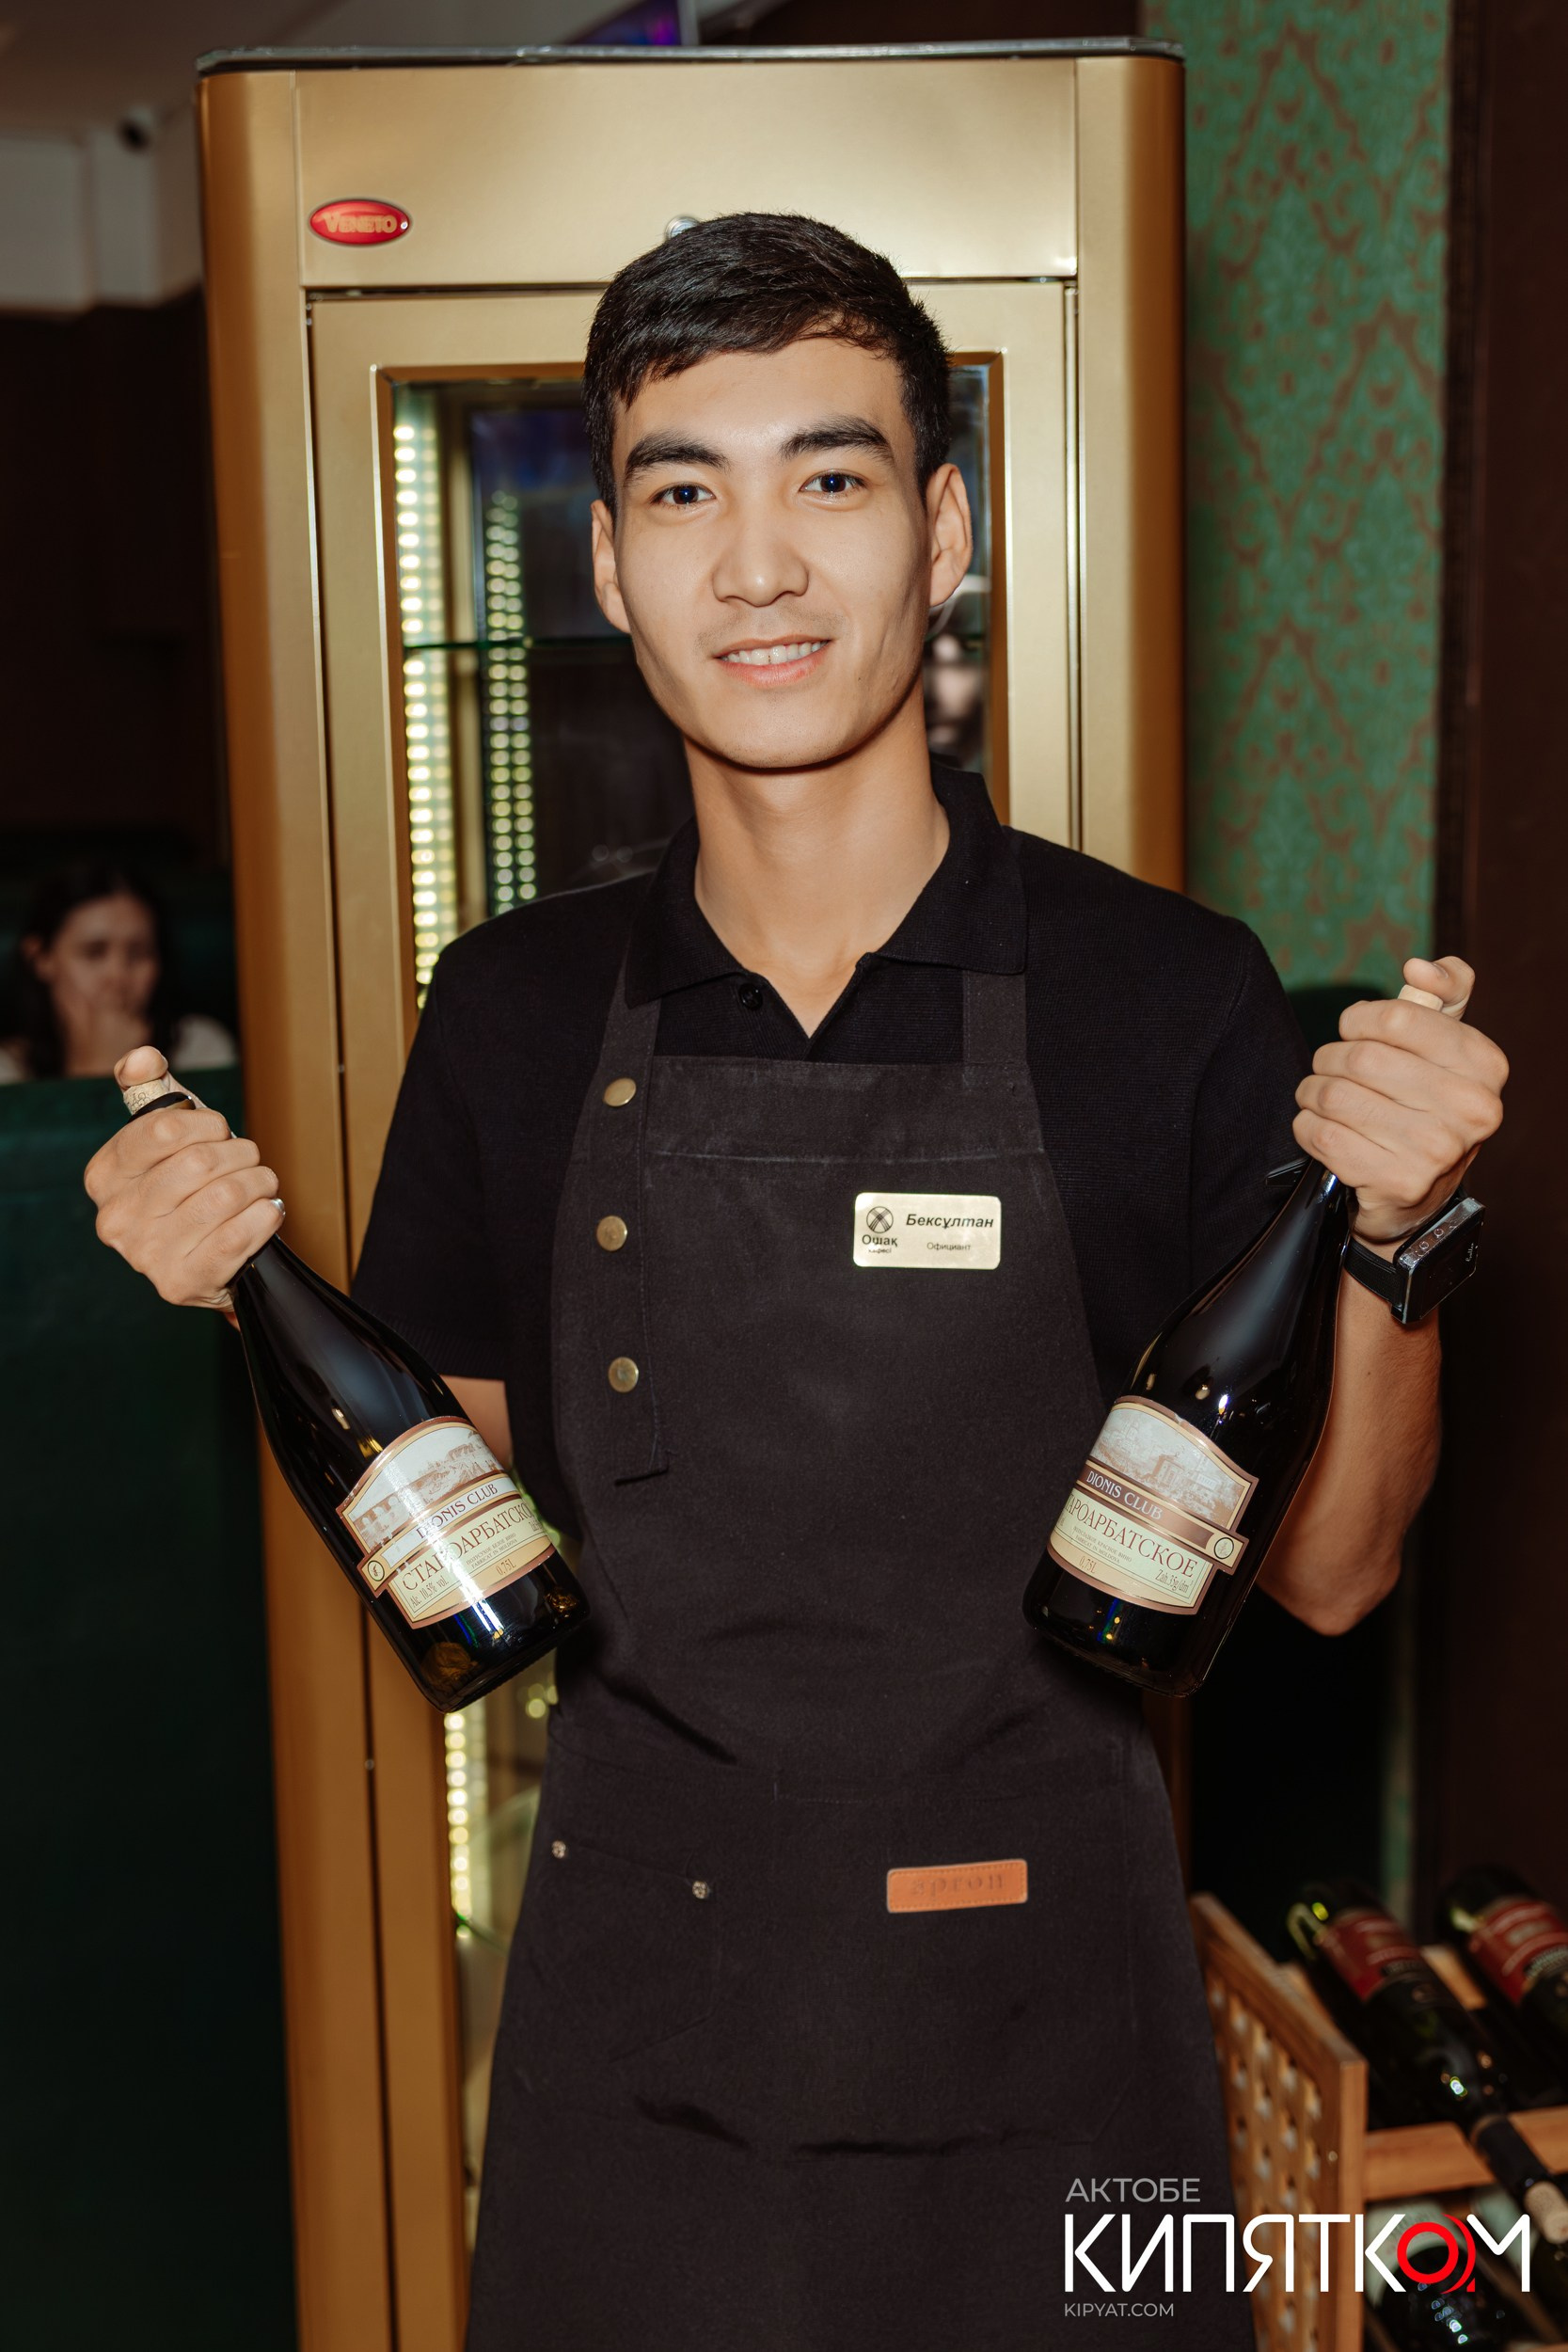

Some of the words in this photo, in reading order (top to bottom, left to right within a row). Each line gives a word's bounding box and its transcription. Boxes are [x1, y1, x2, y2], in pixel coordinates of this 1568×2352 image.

[927, 1242, 972, 1251] Официант
[416, 1501, 466, 1538] DONIS
[467, 1484, 499, 1504] CLUB
[1085, 1470, 1122, 1498] DIONIS
[1124, 1491, 1164, 1519] CLUB
